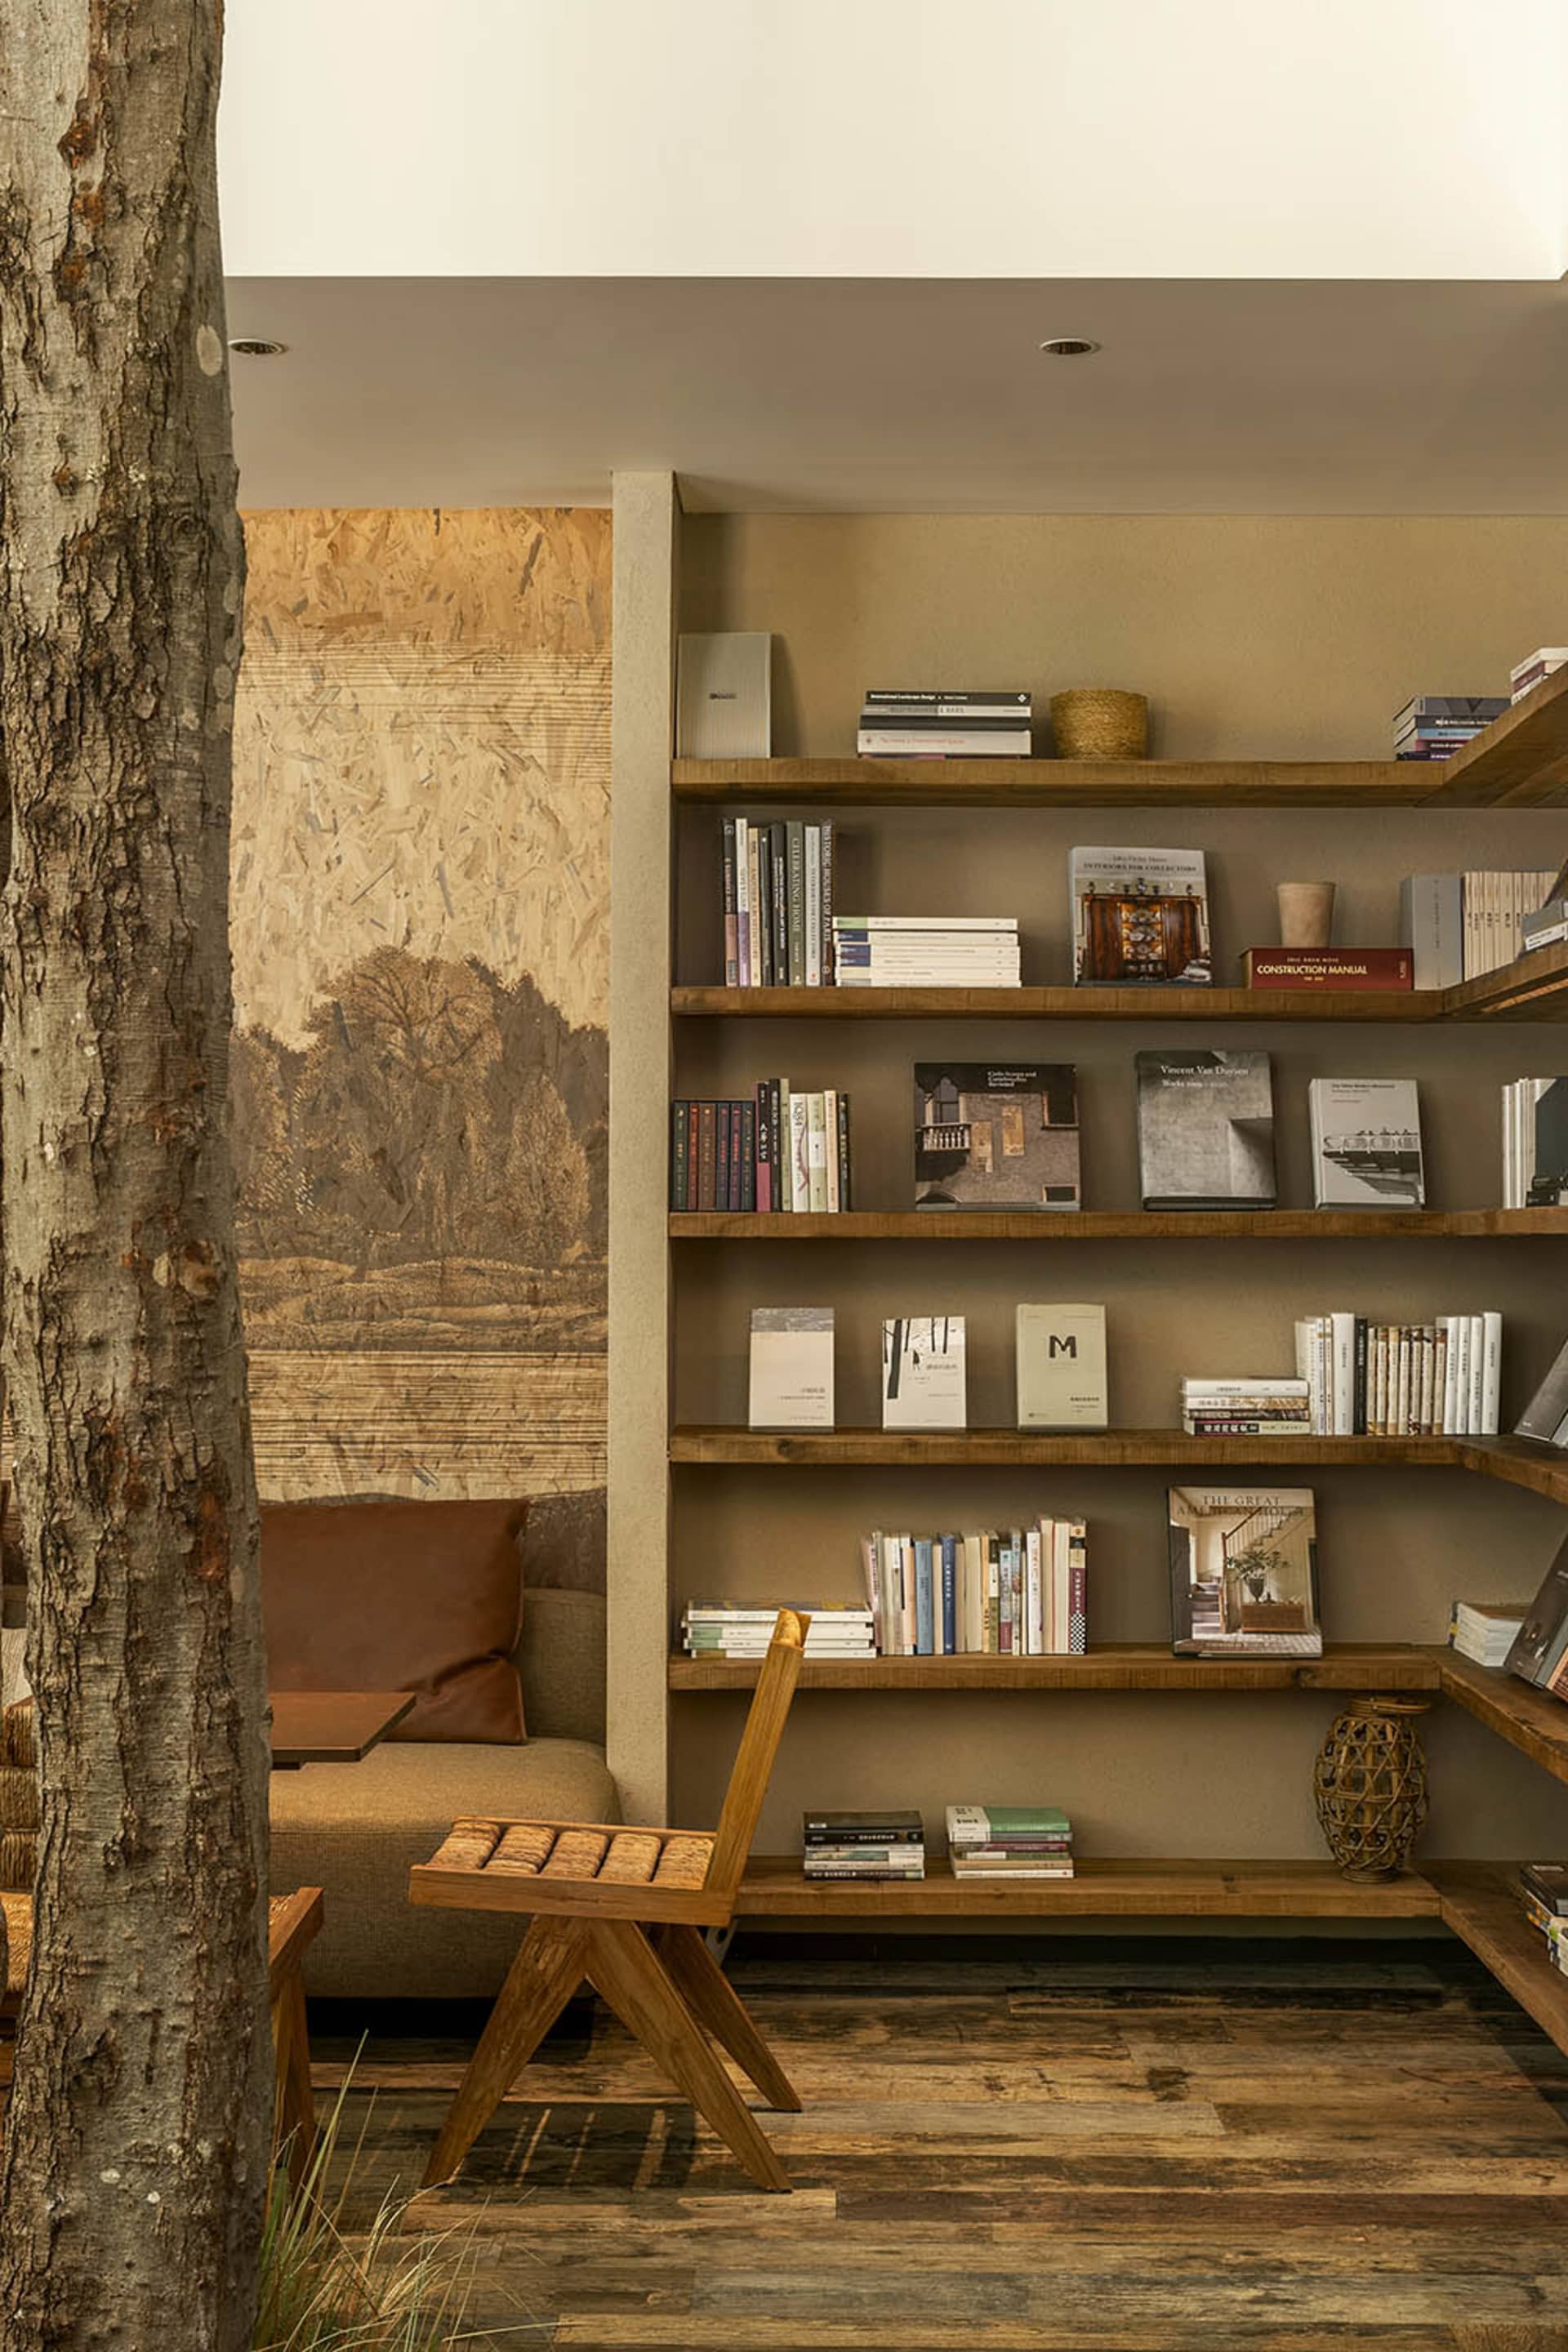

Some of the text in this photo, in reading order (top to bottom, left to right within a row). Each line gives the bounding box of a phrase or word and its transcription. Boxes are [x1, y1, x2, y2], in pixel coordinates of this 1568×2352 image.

[791, 837, 800, 902] CELEBRATING
[822, 825, 832, 942] HISTORIC HOUSES OF PARIS
[791, 904, 800, 932] HOME
[1256, 964, 1367, 975] CONSTRUCTION MANUAL
[1160, 1065, 1249, 1077] Vincent Van Duysen
[1049, 1334, 1077, 1359] M
[1202, 1495, 1281, 1506] THE GREAT
